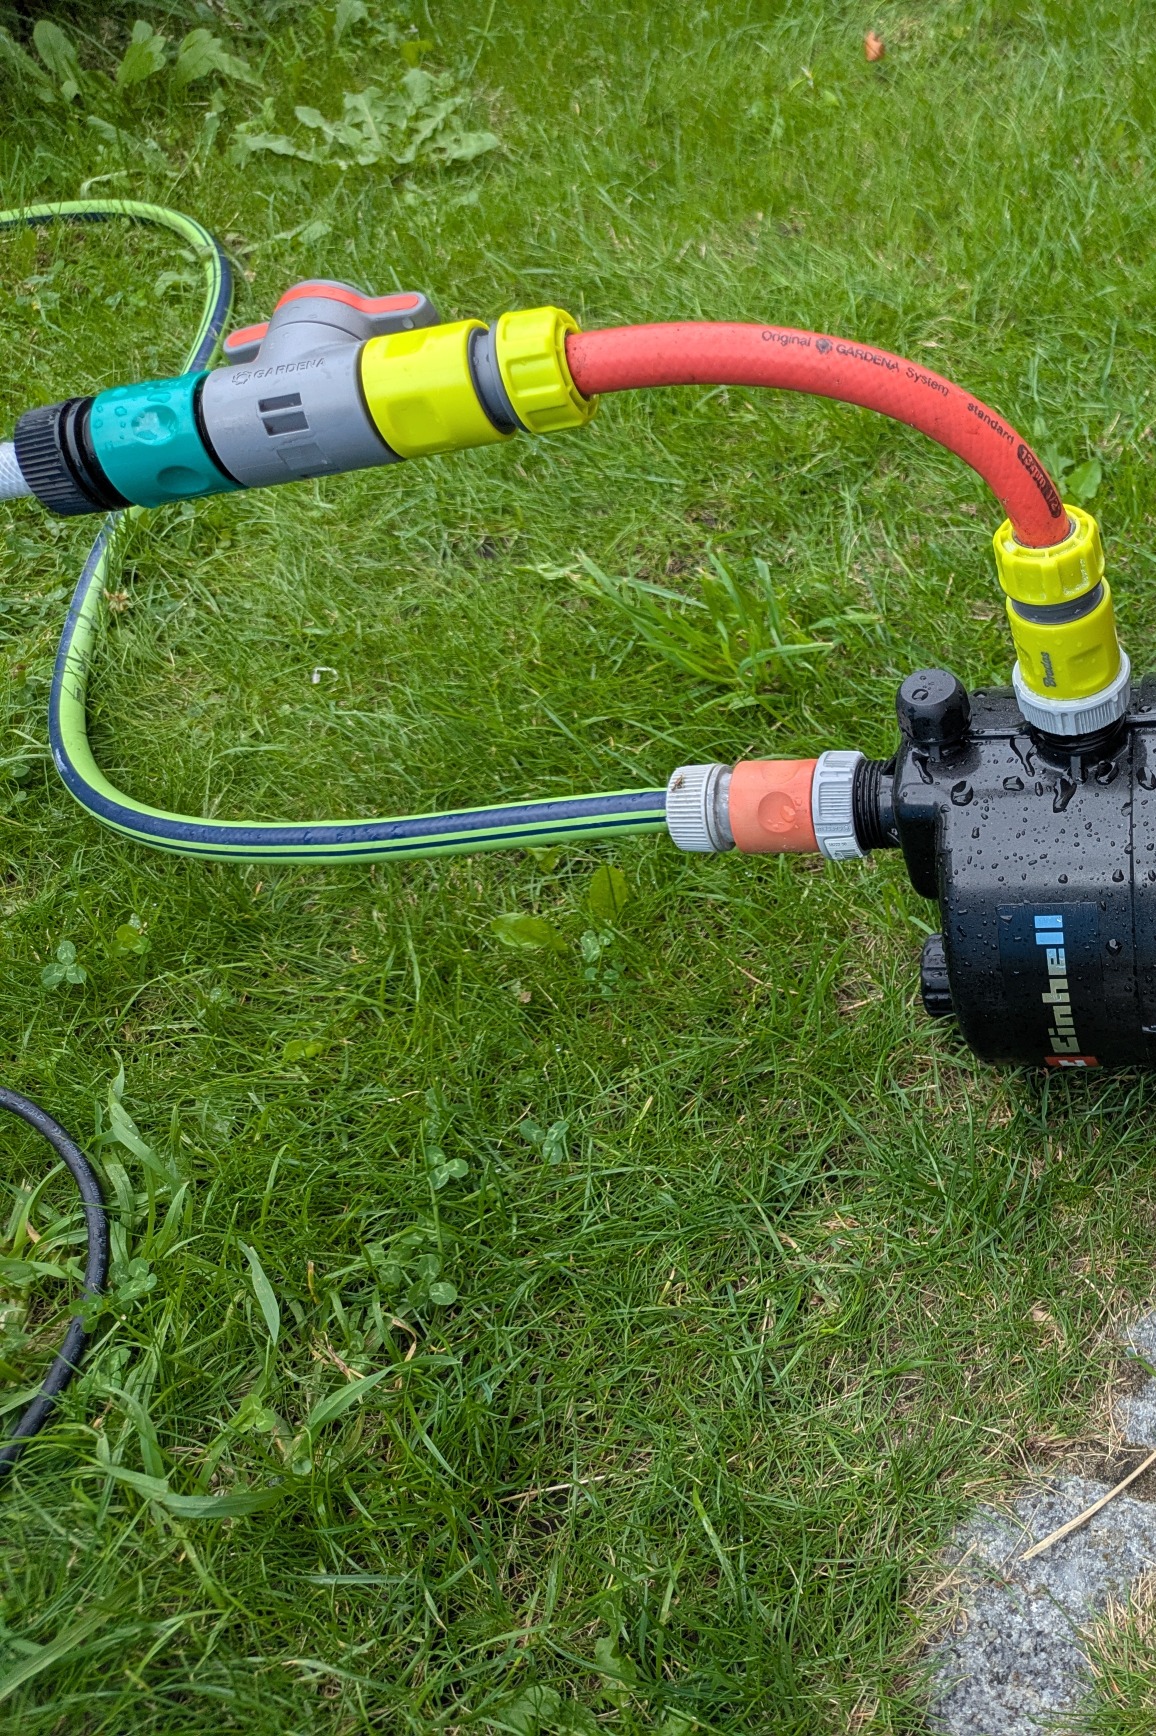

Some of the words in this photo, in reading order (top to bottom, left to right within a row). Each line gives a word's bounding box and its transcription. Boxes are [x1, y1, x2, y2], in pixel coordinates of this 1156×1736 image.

[253, 358, 325, 379] GARDENA
[762, 330, 811, 346] Original
[836, 343, 900, 373] GARDENA
[905, 367, 950, 397] System
[1034, 914, 1081, 1053] Einhell
